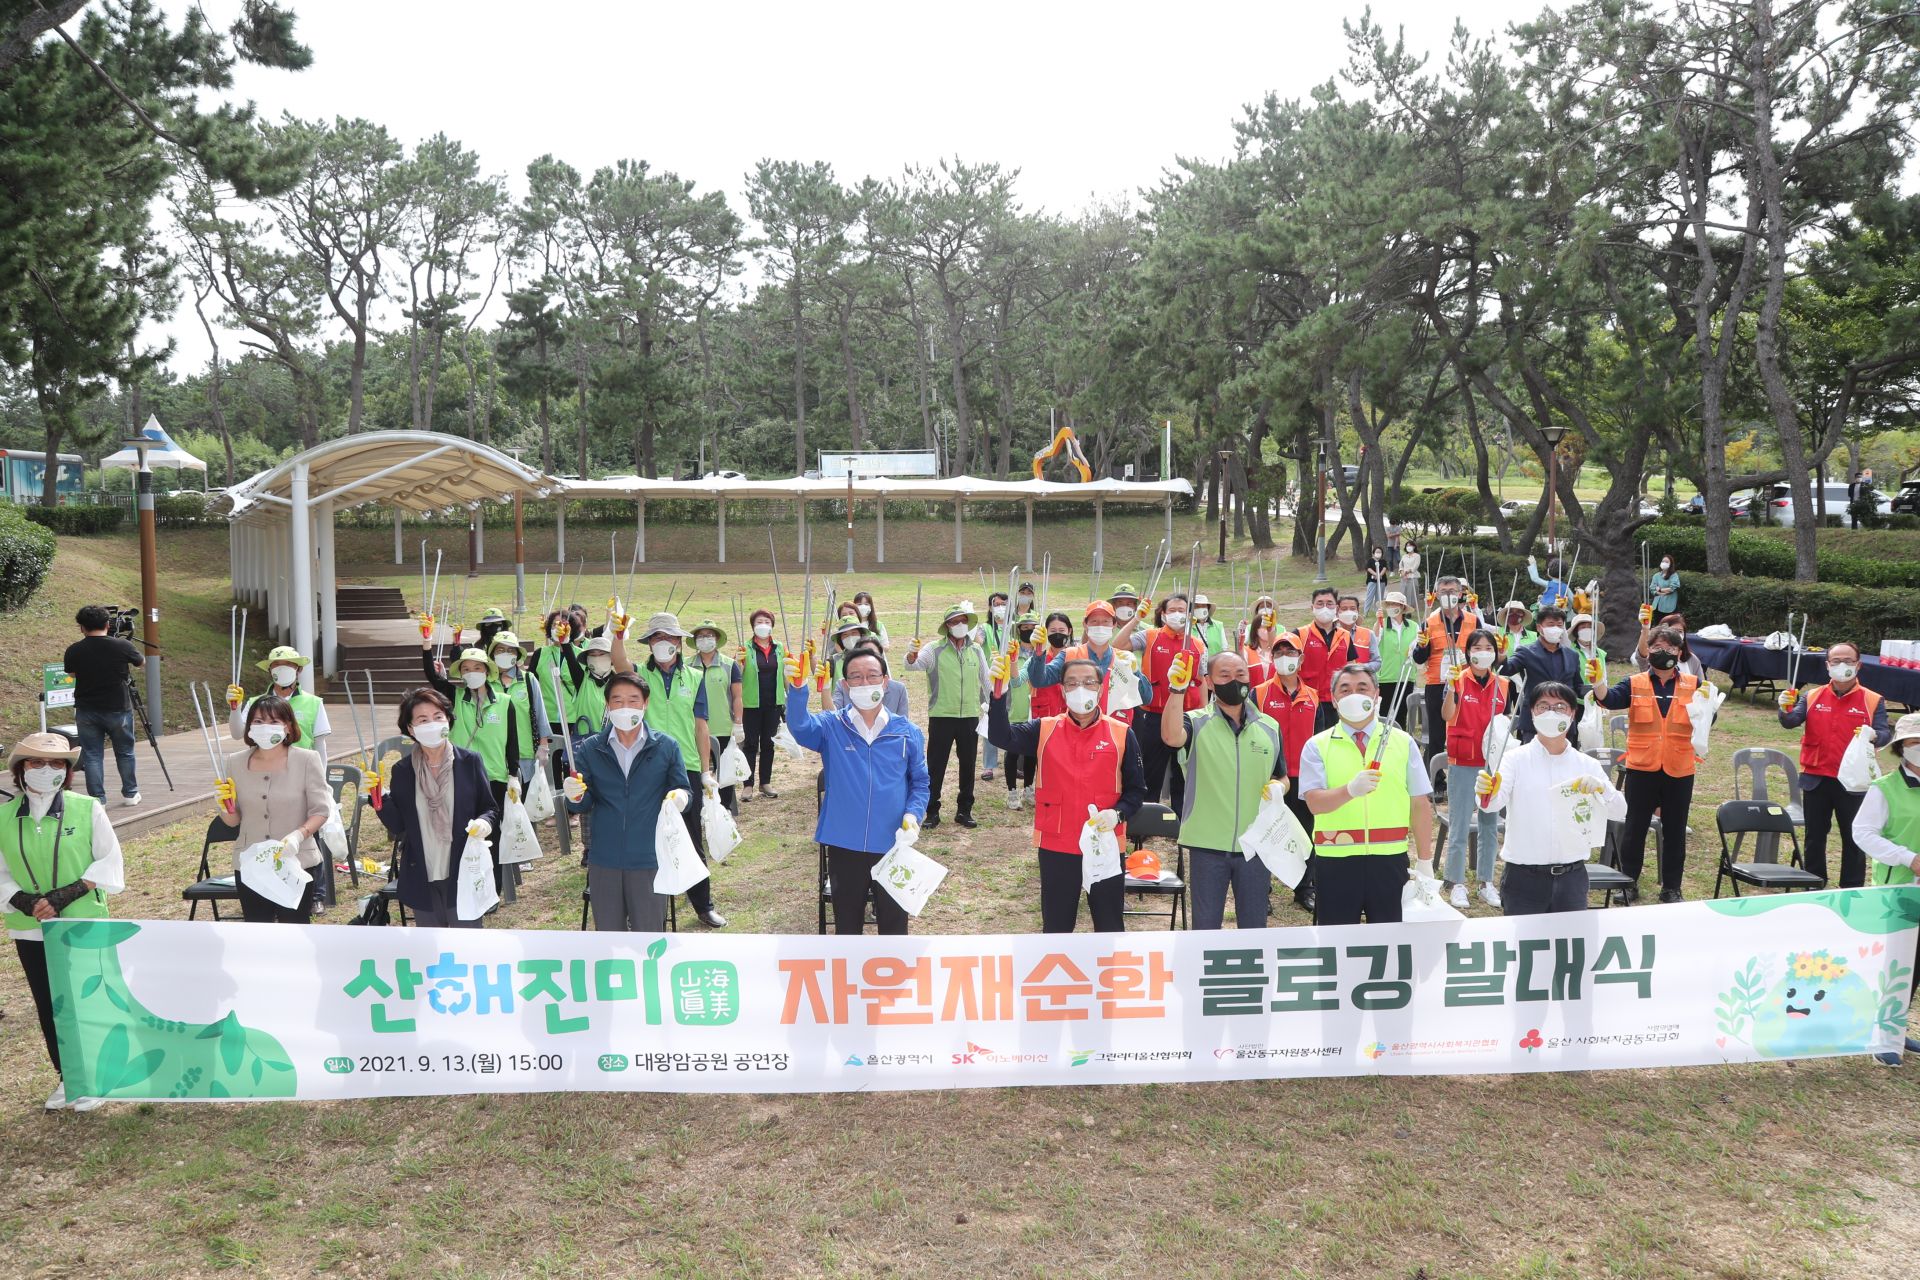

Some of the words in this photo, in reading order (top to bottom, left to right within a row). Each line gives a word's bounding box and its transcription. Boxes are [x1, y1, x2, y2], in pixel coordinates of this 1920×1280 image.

[342, 951, 662, 1035] 산해진미
[778, 951, 1174, 1026] 자원재순환
[1198, 943, 1413, 1017] 플로깅
[1444, 934, 1656, 1008] 발대식
[680, 967, 730, 989] 山海
[1547, 1036, 1573, 1049] 울산
[1575, 1032, 1679, 1046] 사회복지공동모금회
[866, 1054, 933, 1065] 울산광역시
[951, 1053, 975, 1065] SK
[986, 1053, 1049, 1063] 이노베이션
[1095, 1050, 1193, 1061] 그린리더울산협의회
[1235, 1046, 1342, 1060] 울산동구자원봉사센터
[326, 1058, 350, 1072] 일시
[359, 1056, 414, 1072] 2021.
[418, 1055, 436, 1072] 9.
[441, 1053, 502, 1074] 13.(월)
[508, 1054, 563, 1071] 15:00
[601, 1055, 626, 1069] 장소
[635, 1053, 728, 1072] 대왕암공원
[733, 1053, 789, 1071] 공연장
